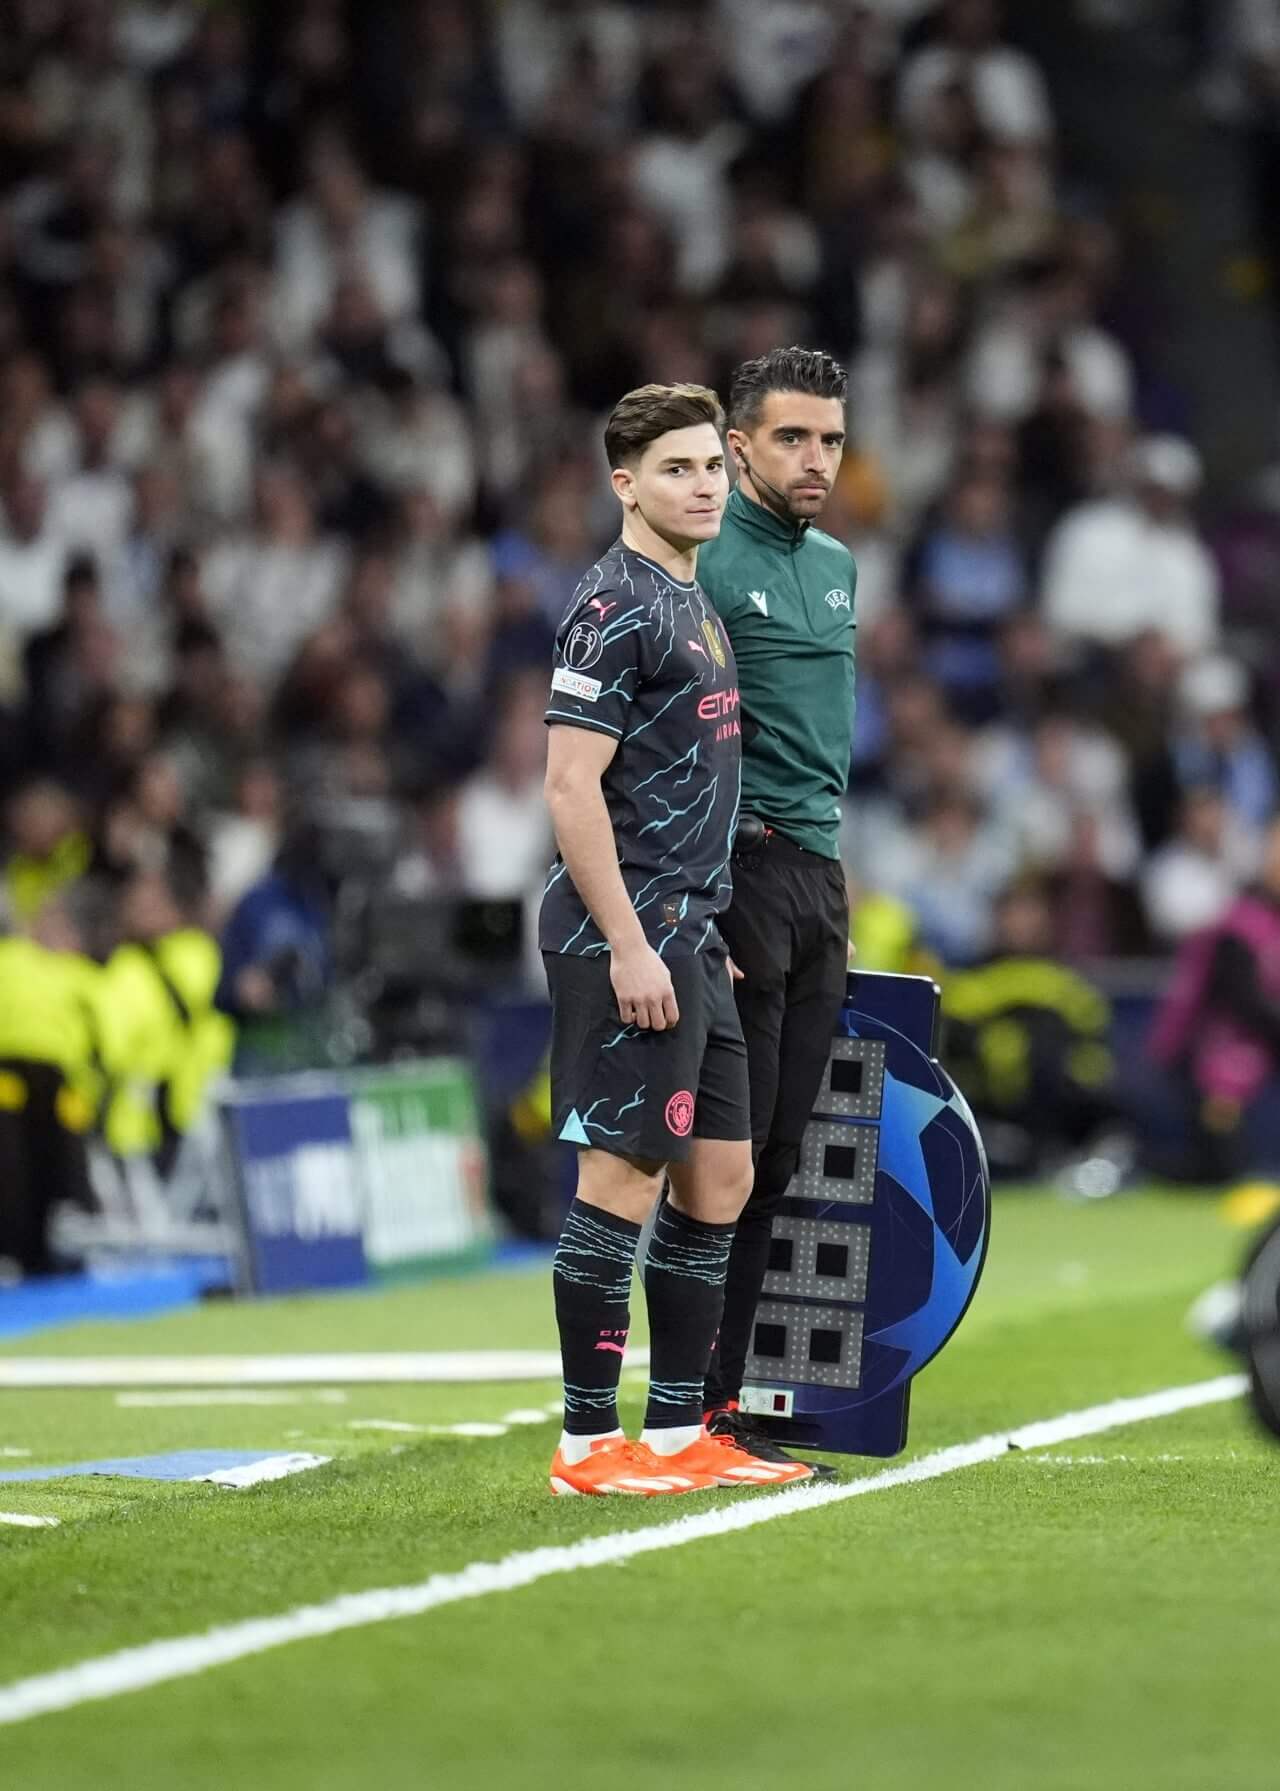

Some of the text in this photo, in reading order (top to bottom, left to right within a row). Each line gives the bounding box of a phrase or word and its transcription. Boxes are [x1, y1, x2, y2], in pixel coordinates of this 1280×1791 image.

[697, 687, 740, 720] ETIHA
[715, 719, 741, 743] AIRWA
[600, 1329, 629, 1337] CIT
